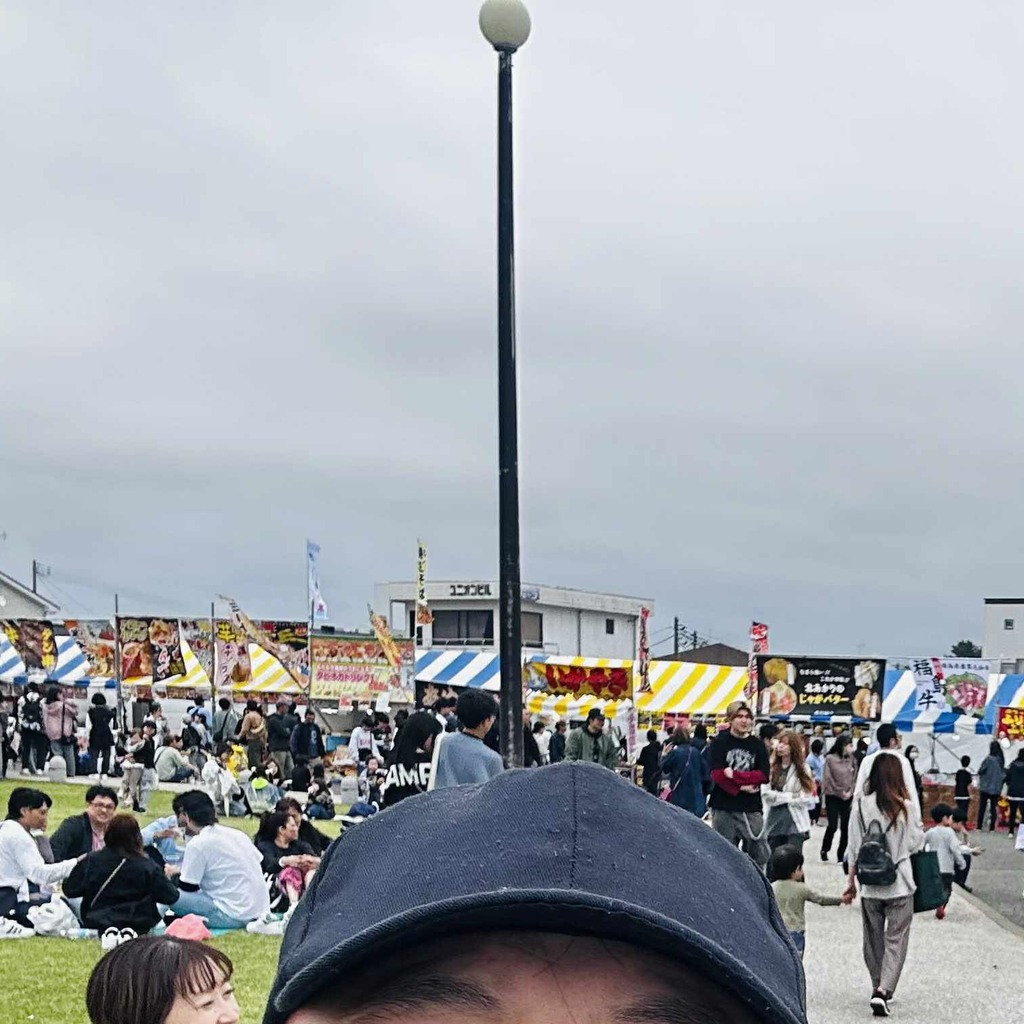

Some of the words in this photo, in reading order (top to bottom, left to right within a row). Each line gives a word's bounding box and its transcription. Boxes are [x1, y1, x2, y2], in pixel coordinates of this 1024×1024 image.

[450, 584, 492, 596] ユニオンビル
[799, 692, 850, 705] じゃがバター
